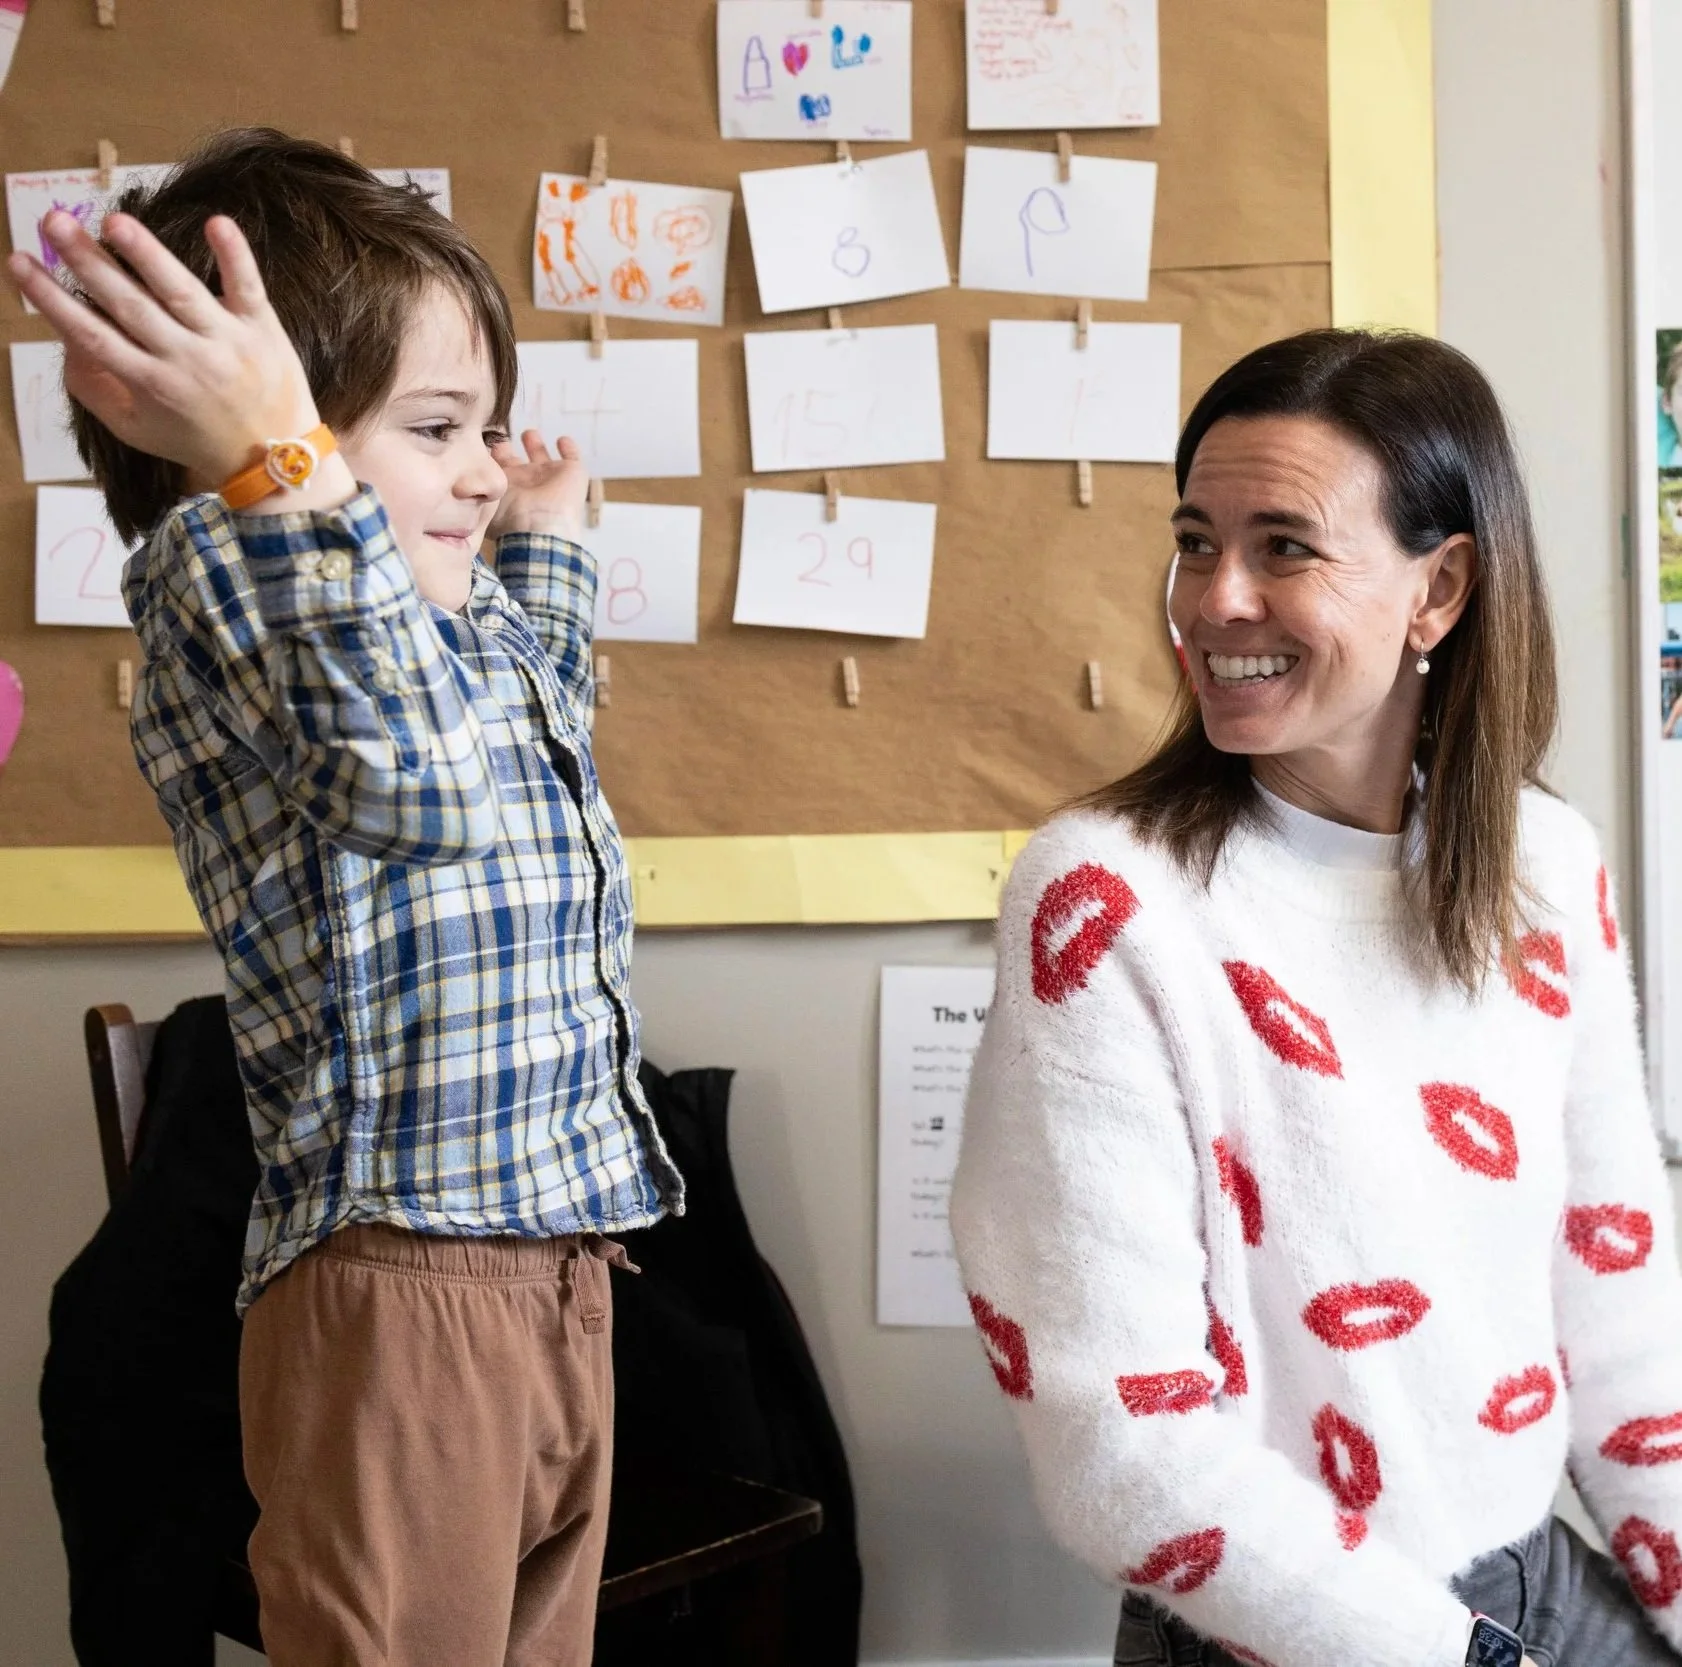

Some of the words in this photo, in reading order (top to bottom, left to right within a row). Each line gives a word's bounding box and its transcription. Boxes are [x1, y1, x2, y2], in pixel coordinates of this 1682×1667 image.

[832, 226, 870, 277] 8
[797, 531, 873, 587] 29
[597, 556, 648, 626] 8
[932, 1006, 967, 1022] The
